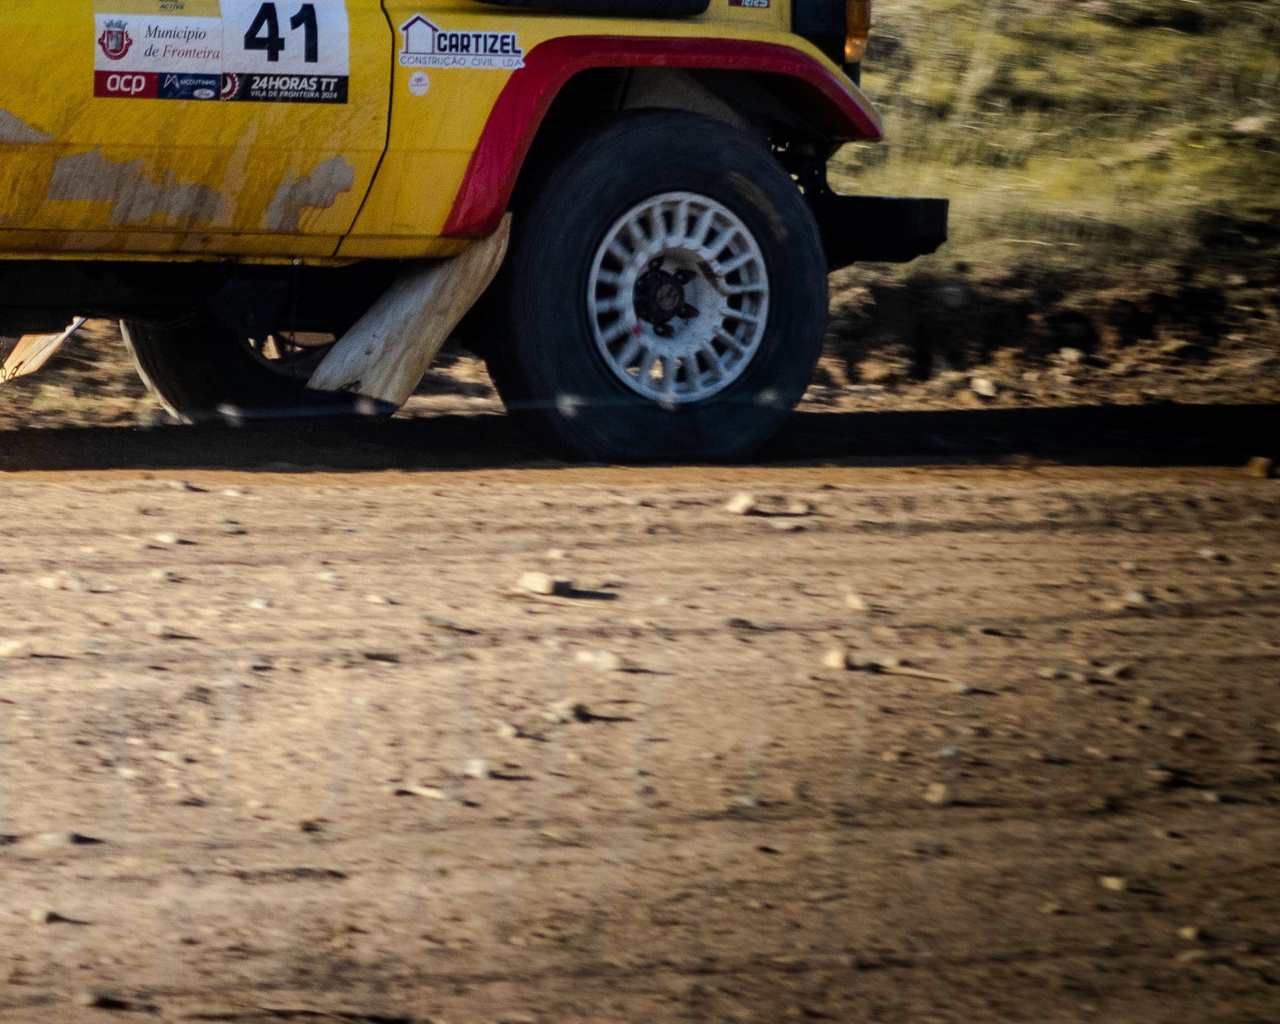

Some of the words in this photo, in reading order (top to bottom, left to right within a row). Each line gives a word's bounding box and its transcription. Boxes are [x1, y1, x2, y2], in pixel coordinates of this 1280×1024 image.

[144, 24, 207, 42] Município
[243, 2, 318, 63] 41
[437, 33, 522, 54] CARTIZEL
[144, 45, 160, 58] de
[162, 45, 220, 60] Fronteira
[400, 55, 467, 67] CONSTRUÇÃO
[106, 74, 146, 96] acp
[319, 77, 338, 91] TT
[267, 90, 278, 98] DE
[278, 90, 320, 99] FRONTEIRA
[320, 91, 338, 99] 2024
